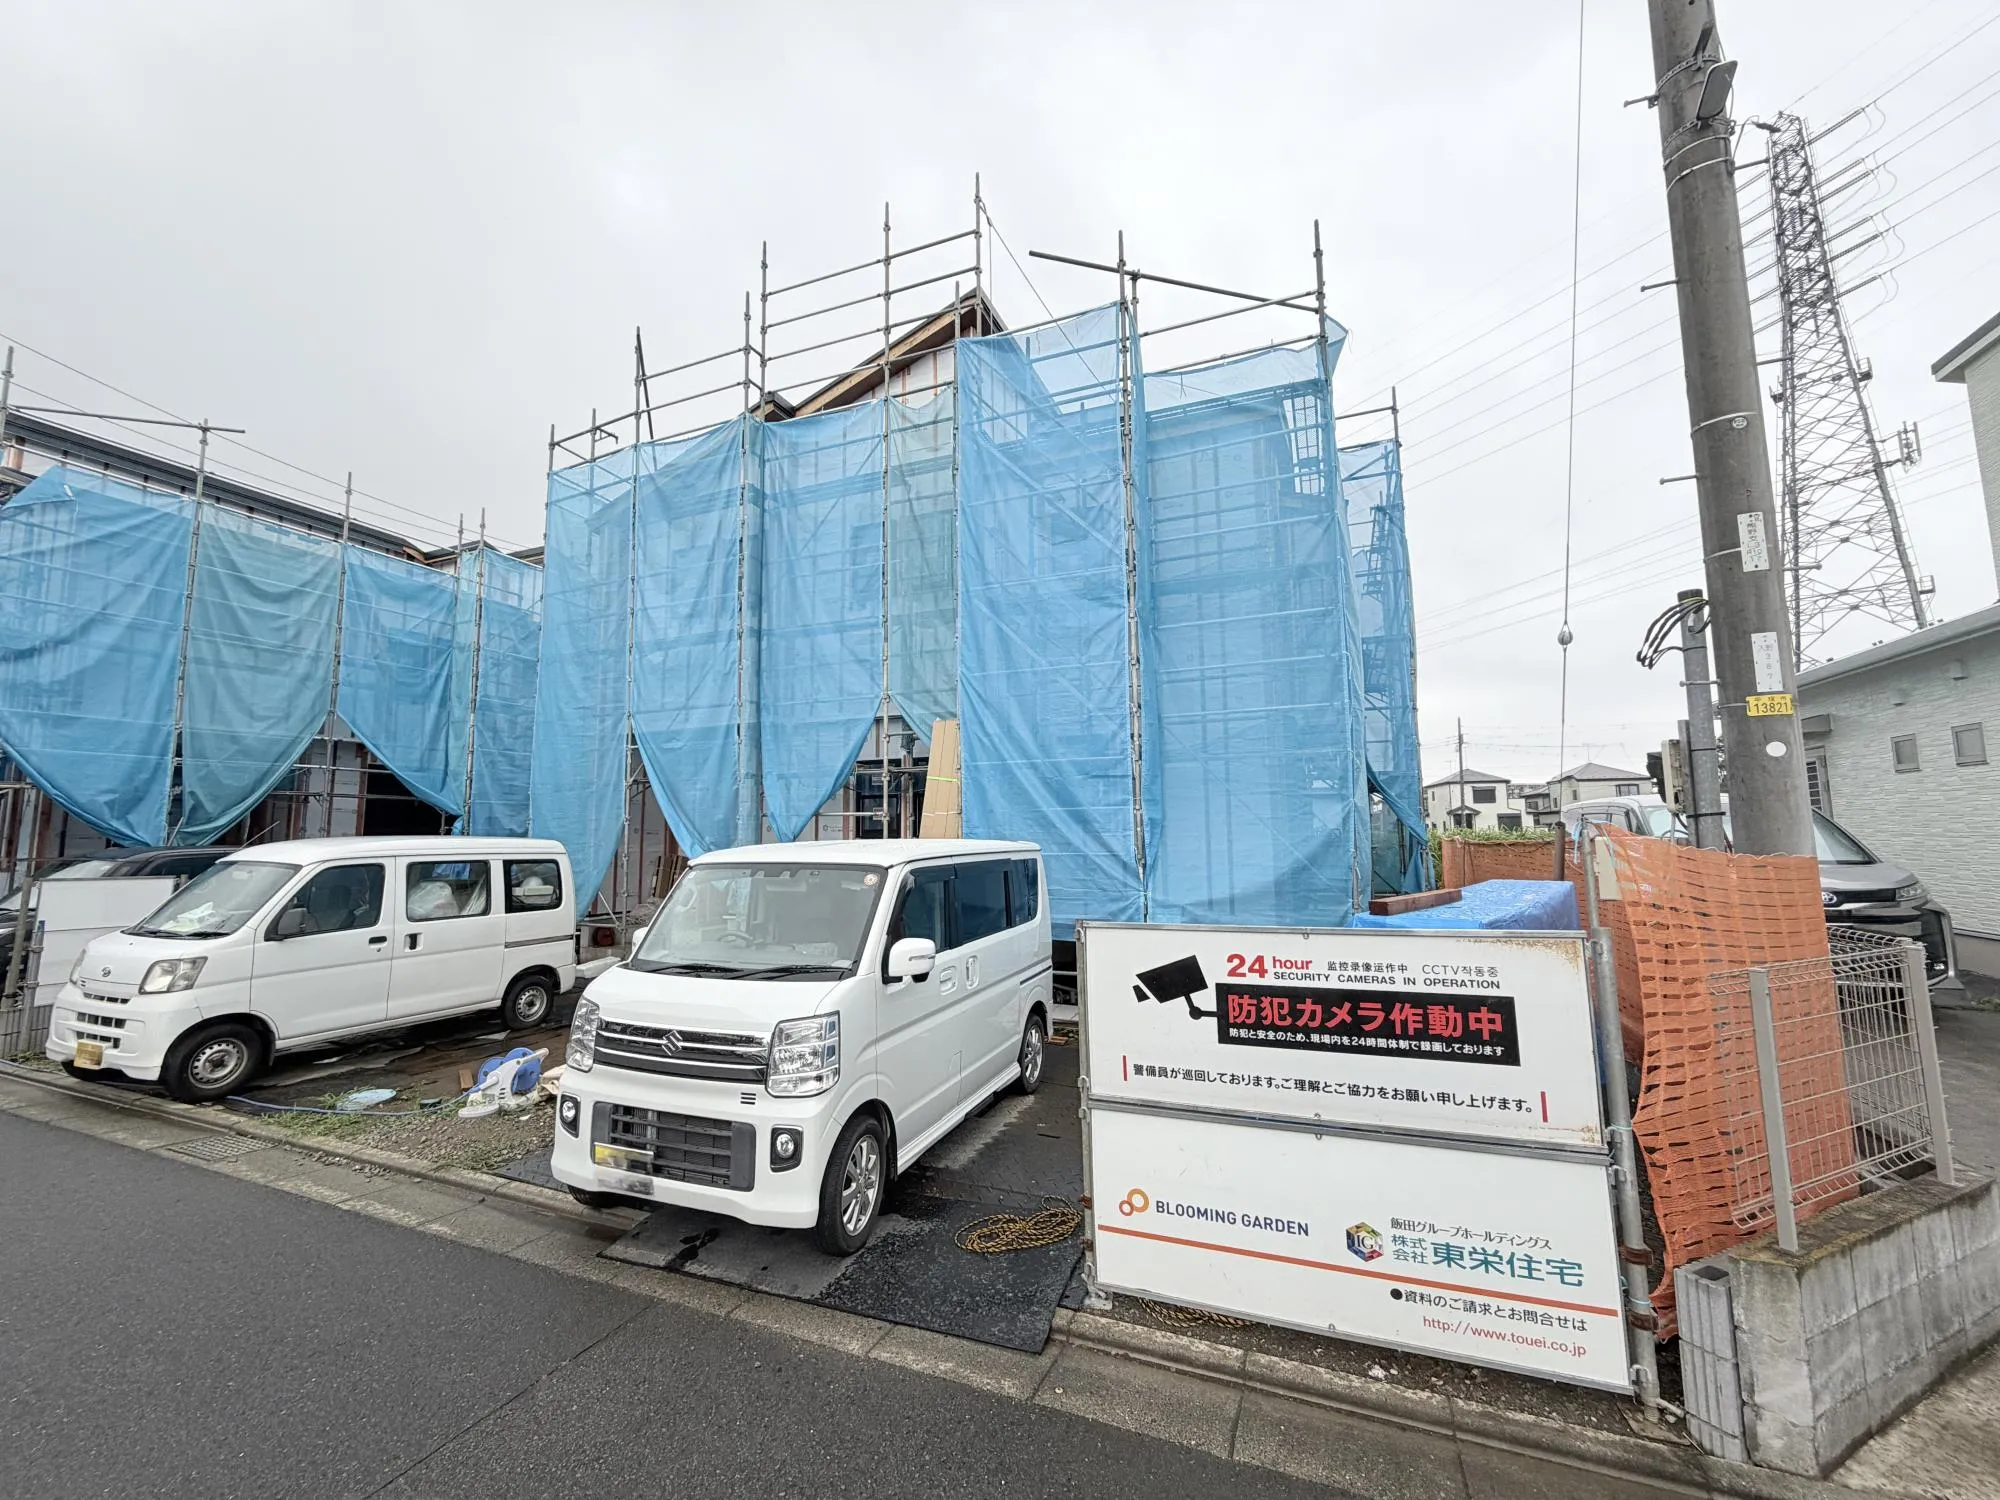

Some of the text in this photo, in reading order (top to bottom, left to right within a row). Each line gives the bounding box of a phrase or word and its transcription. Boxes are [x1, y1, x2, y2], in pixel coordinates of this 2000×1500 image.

[1753, 702, 1788, 714] 13821
[1226, 953, 1313, 979] 24 hour
[1273, 971, 1500, 989] SECURITY CAMERAS IN OPERATION
[1327, 960, 1408, 975] 监控录像运作中
[1227, 994, 1504, 1041] 防犯カメラ作動中
[1229, 1027, 1505, 1057] 防犯と安全のため、現場内を24時間体制で録画しております
[1155, 1200, 1310, 1237] BLOOMING GARDEN
[1390, 1216, 1553, 1251] 飯田グループホールディングス
[1391, 1233, 1428, 1251] 株式
[1392, 1248, 1429, 1265] 会社
[1430, 1241, 1585, 1288] 東栄住宅
[1423, 1315, 1588, 1357] http://www.touei.co.jp
